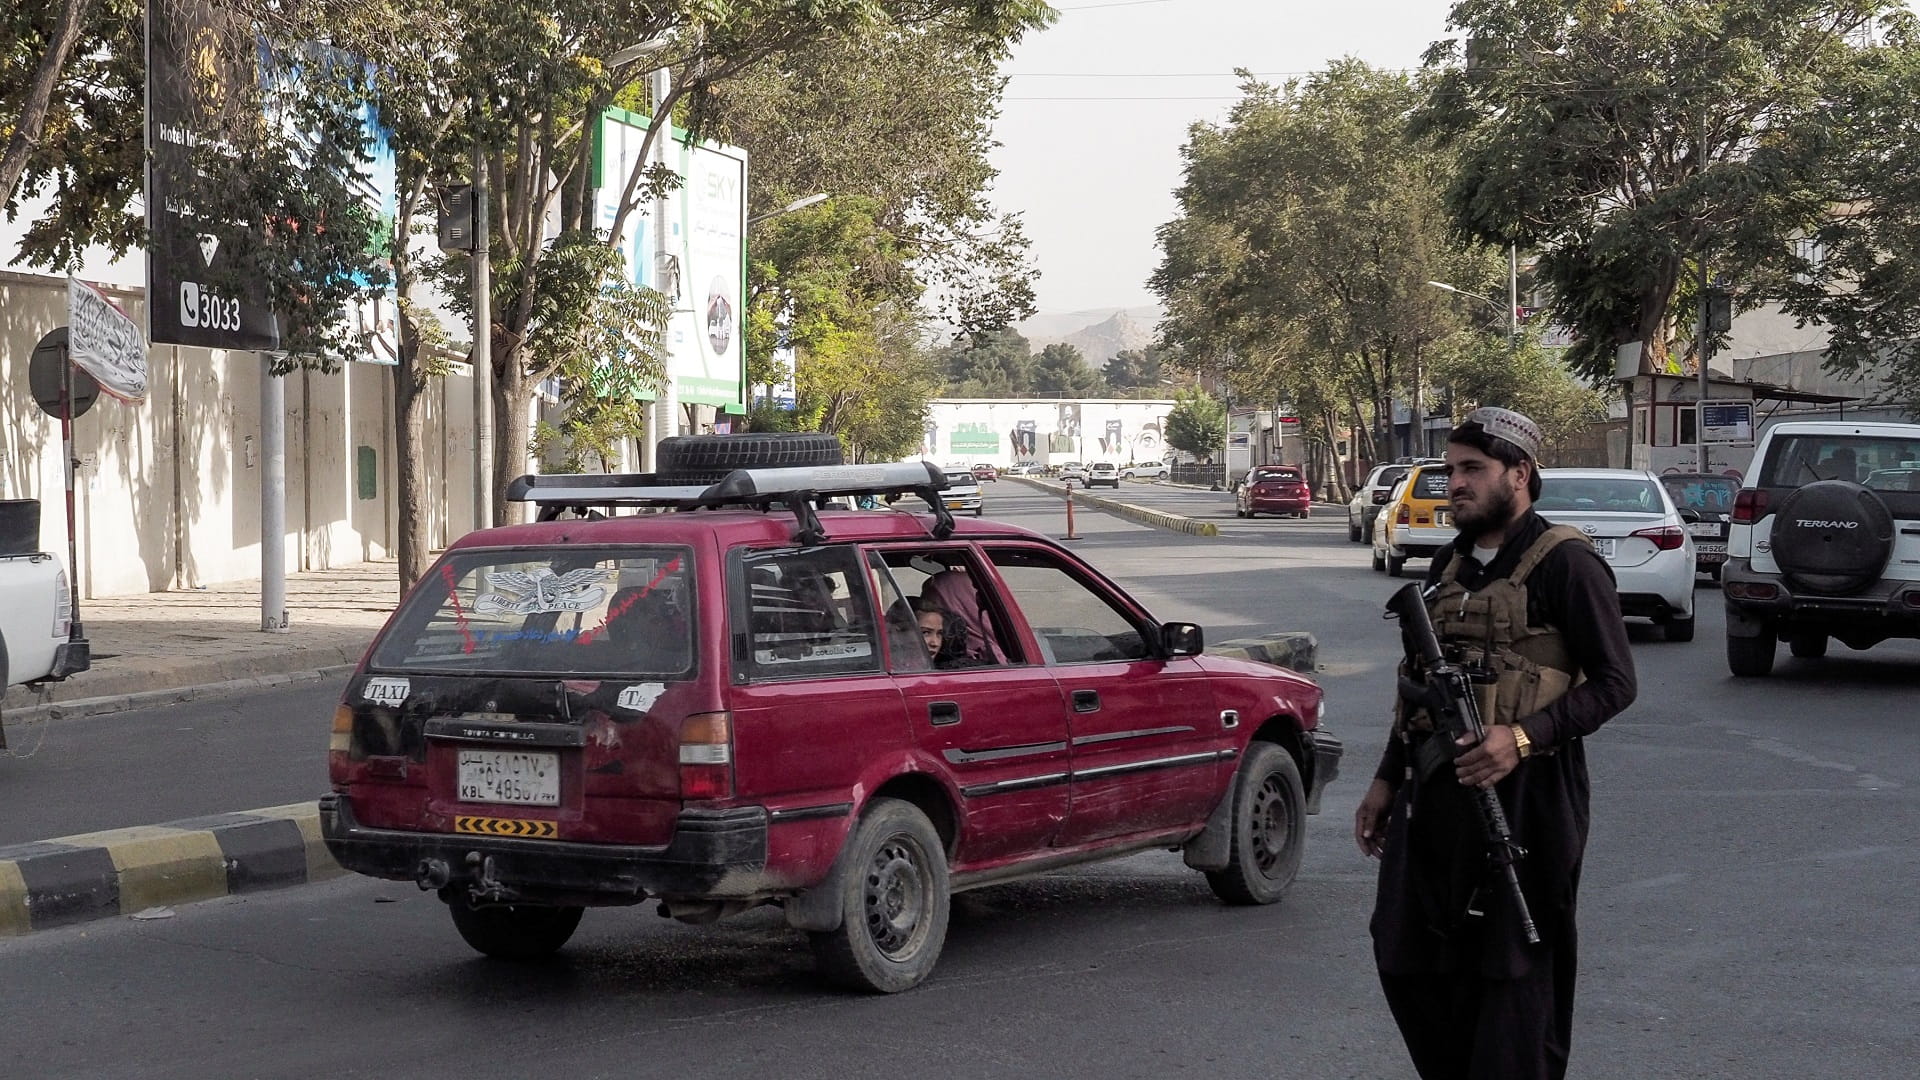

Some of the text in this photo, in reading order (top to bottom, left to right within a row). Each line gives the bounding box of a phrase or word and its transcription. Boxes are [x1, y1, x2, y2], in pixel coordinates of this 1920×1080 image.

[160, 122, 184, 145] Hotel
[708, 172, 736, 203] SKY
[200, 293, 241, 332] 3033
[1796, 519, 1859, 529] TERRANO
[491, 595, 521, 610] LIBERTY
[547, 602, 581, 610] PEACE
[370, 684, 409, 700] TAXI
[463, 729, 535, 740] TOYOTA COROLLA
[462, 785, 485, 799] KBL
